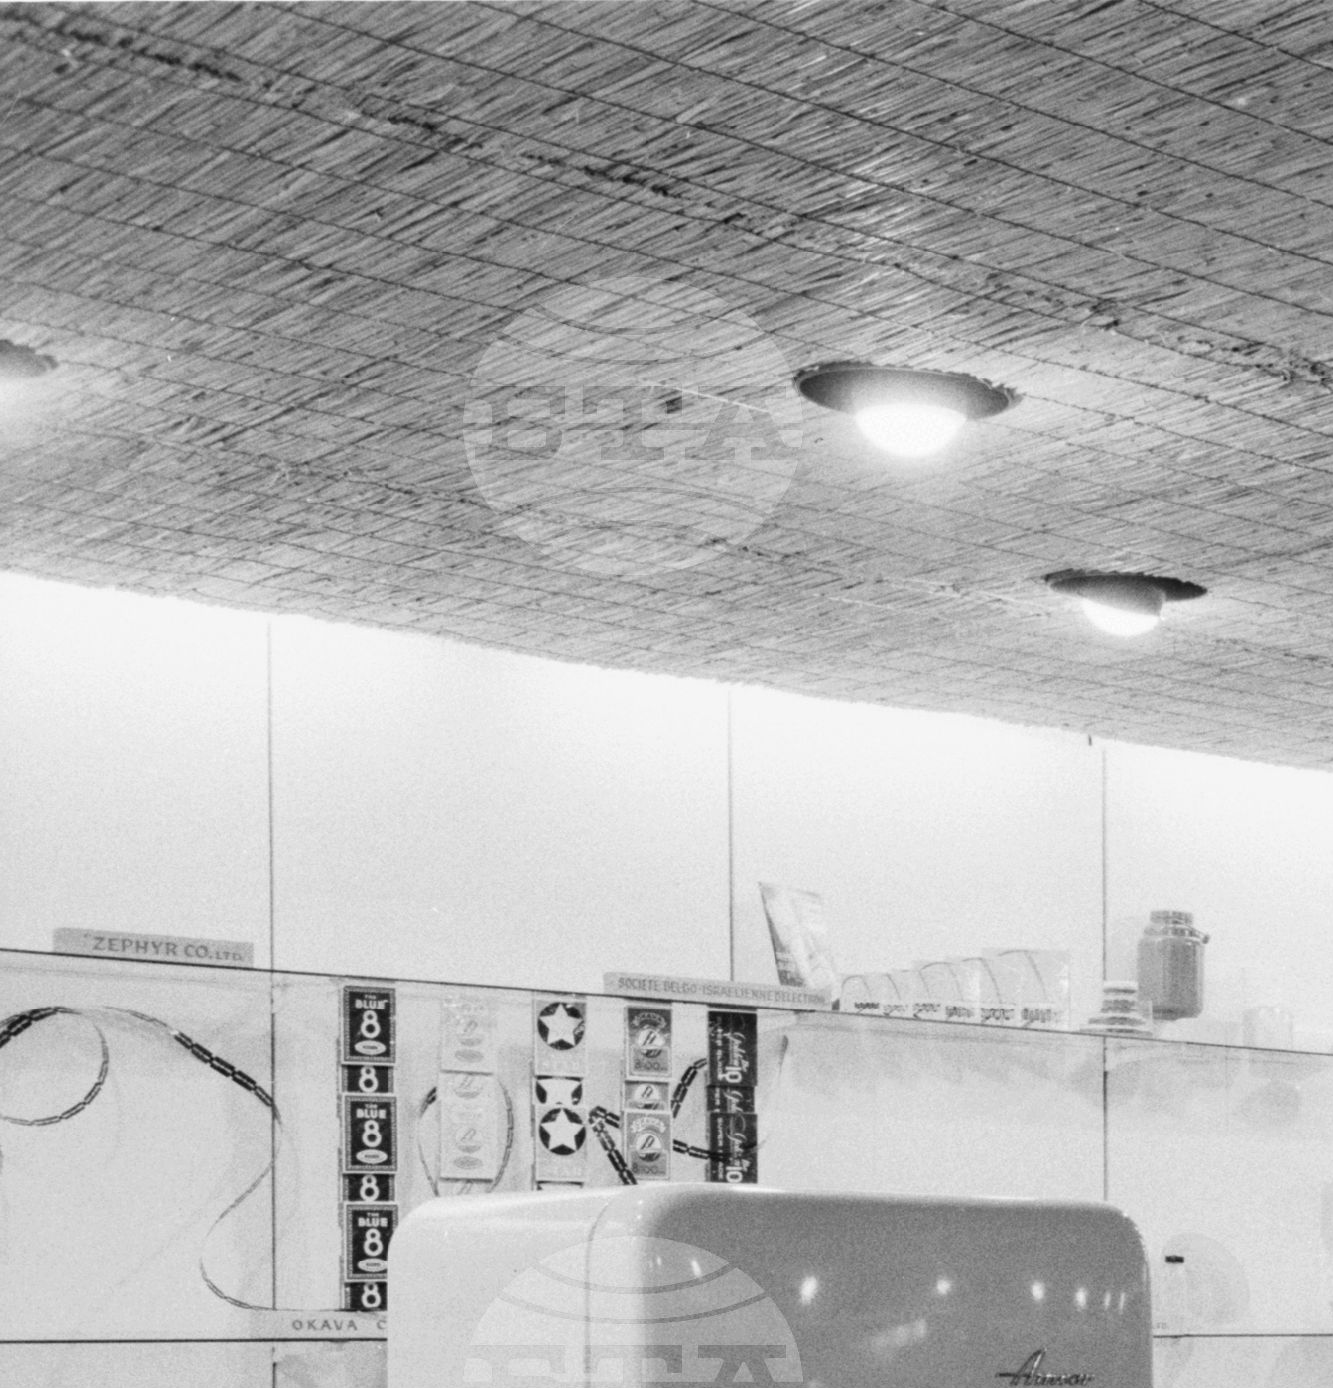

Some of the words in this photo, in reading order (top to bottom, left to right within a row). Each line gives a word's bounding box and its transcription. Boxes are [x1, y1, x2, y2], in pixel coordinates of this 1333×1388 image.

[354, 1000, 388, 1010] BLUE
[360, 1010, 382, 1039] 8
[358, 1066, 379, 1093] 8
[355, 1109, 388, 1120] BLUE
[361, 1120, 382, 1148] 8
[359, 1174, 380, 1201] 8
[357, 1218, 388, 1228] BLUE
[363, 1228, 384, 1257] 8
[361, 1282, 382, 1308] 8
[291, 1319, 358, 1331] OKAVA
